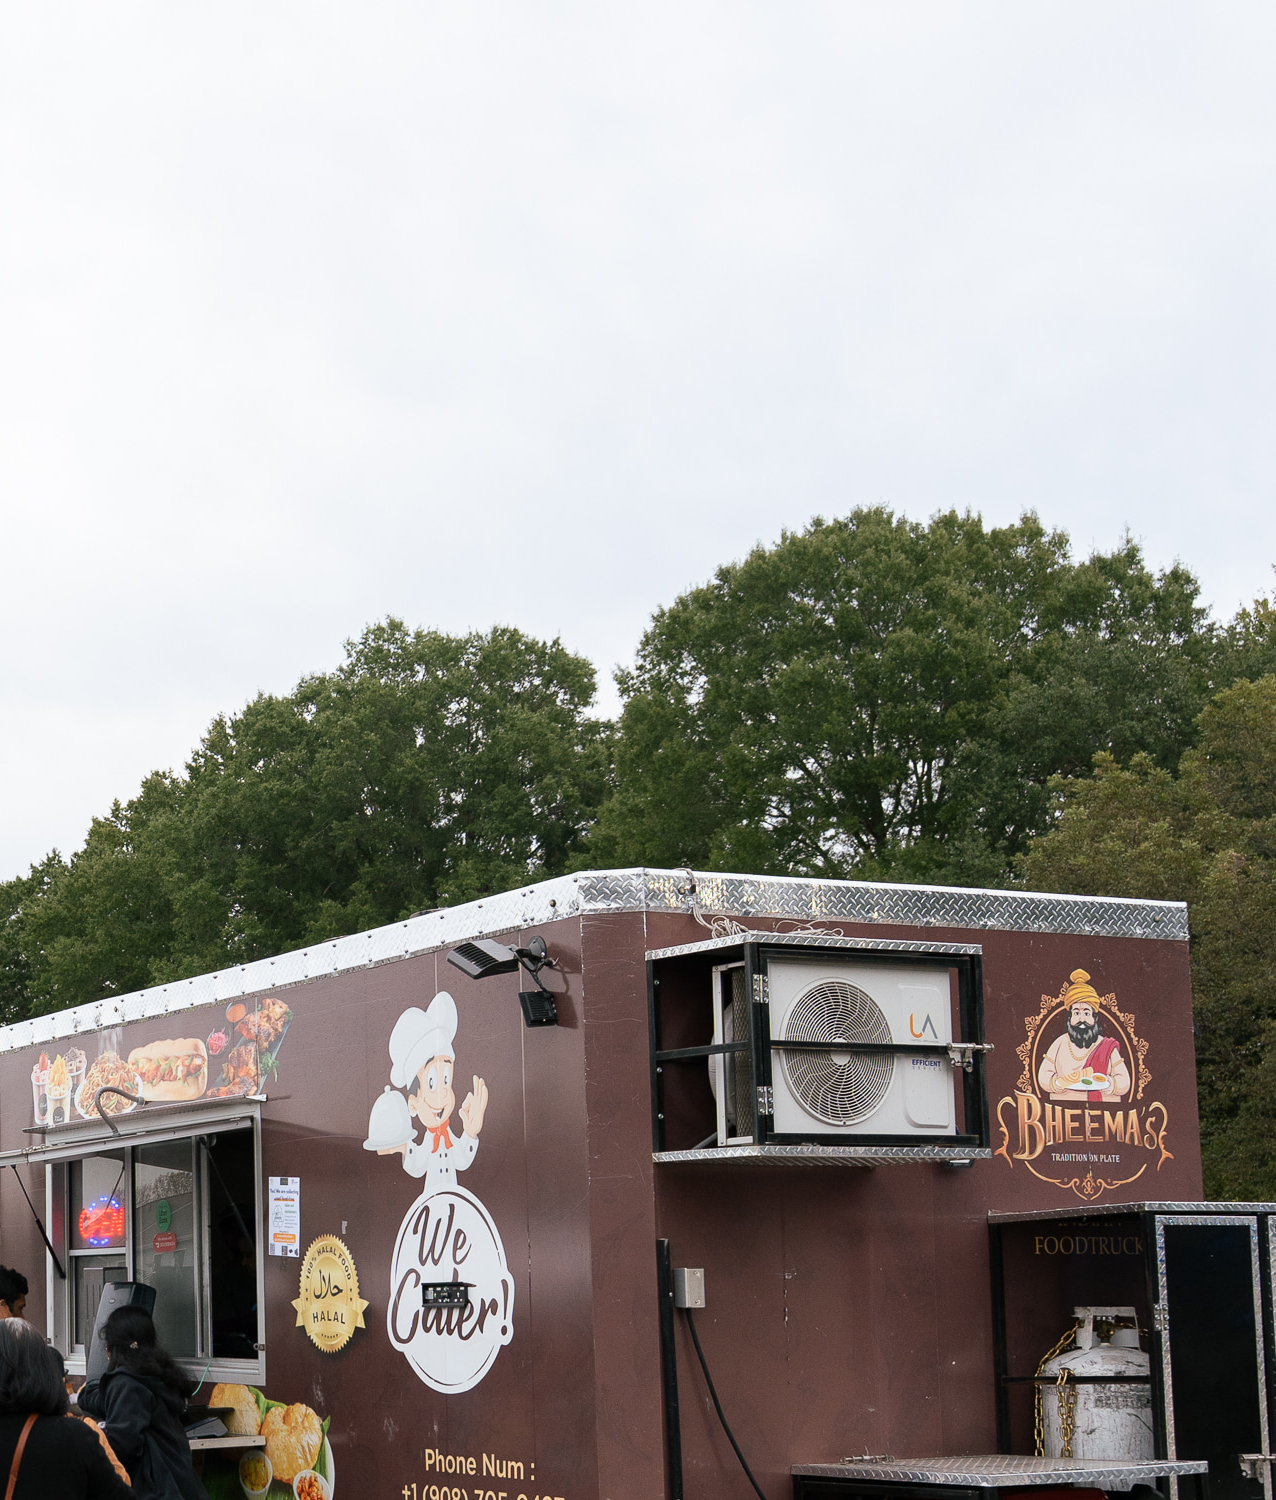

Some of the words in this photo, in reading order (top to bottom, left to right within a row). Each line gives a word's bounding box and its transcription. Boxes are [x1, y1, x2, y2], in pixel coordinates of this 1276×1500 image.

[911, 1058, 942, 1068] EFFICIENT
[1050, 1152, 1088, 1163] TRADITION
[1088, 1152, 1099, 1163] ON
[1099, 1154, 1121, 1164] PLATE
[412, 1203, 473, 1267] We
[1034, 1235, 1144, 1256] FOODTRUCK
[305, 1256, 318, 1279] 100%
[317, 1245, 337, 1257] HALAL
[338, 1253, 352, 1281] FOOD
[313, 1268, 344, 1300] حلال
[312, 1310, 346, 1325] HALAL
[391, 1267, 510, 1345] Cater!
[424, 1448, 477, 1476] Phone
[482, 1452, 525, 1480] Num
